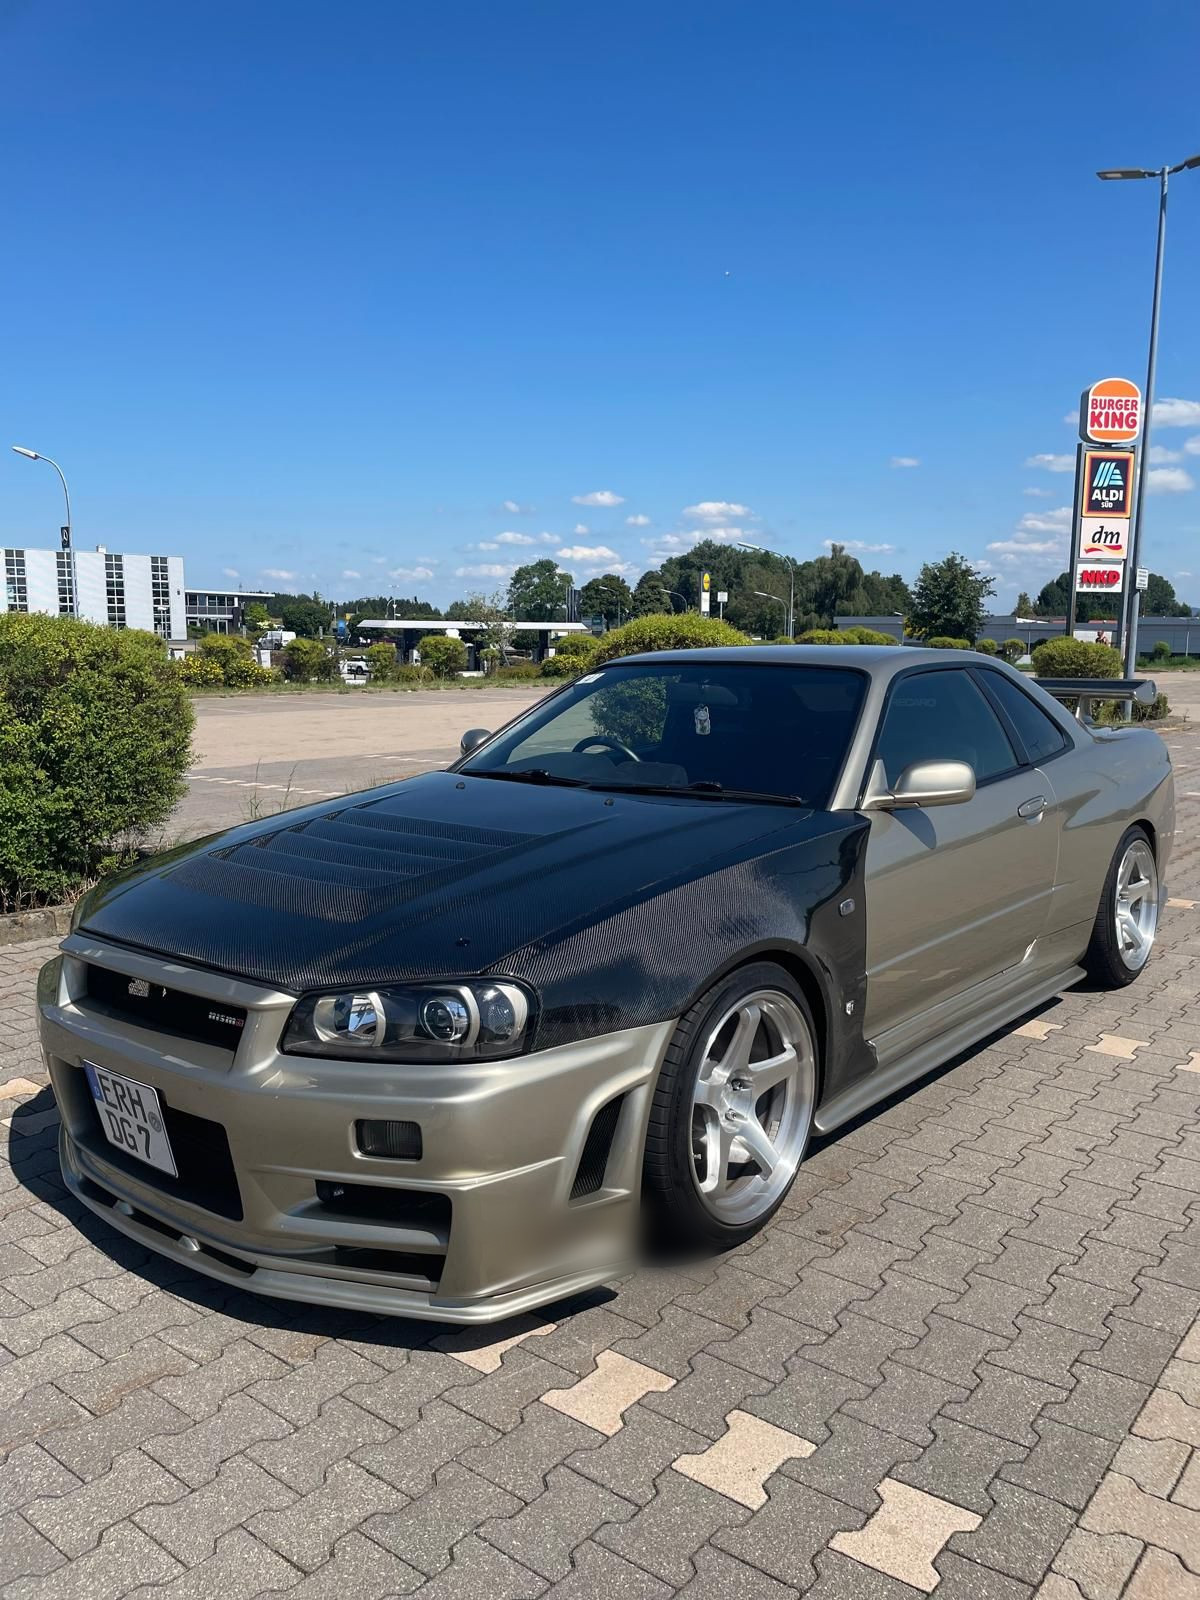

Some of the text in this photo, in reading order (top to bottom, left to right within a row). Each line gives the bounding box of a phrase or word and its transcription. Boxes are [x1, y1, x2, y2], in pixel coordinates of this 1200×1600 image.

[1090, 398, 1138, 411] BURGER
[1090, 411, 1137, 429] KING
[1092, 489, 1123, 501] ALDI
[1092, 526, 1120, 543] dm
[1081, 570, 1120, 588] NKD
[97, 1073, 148, 1123] ERH
